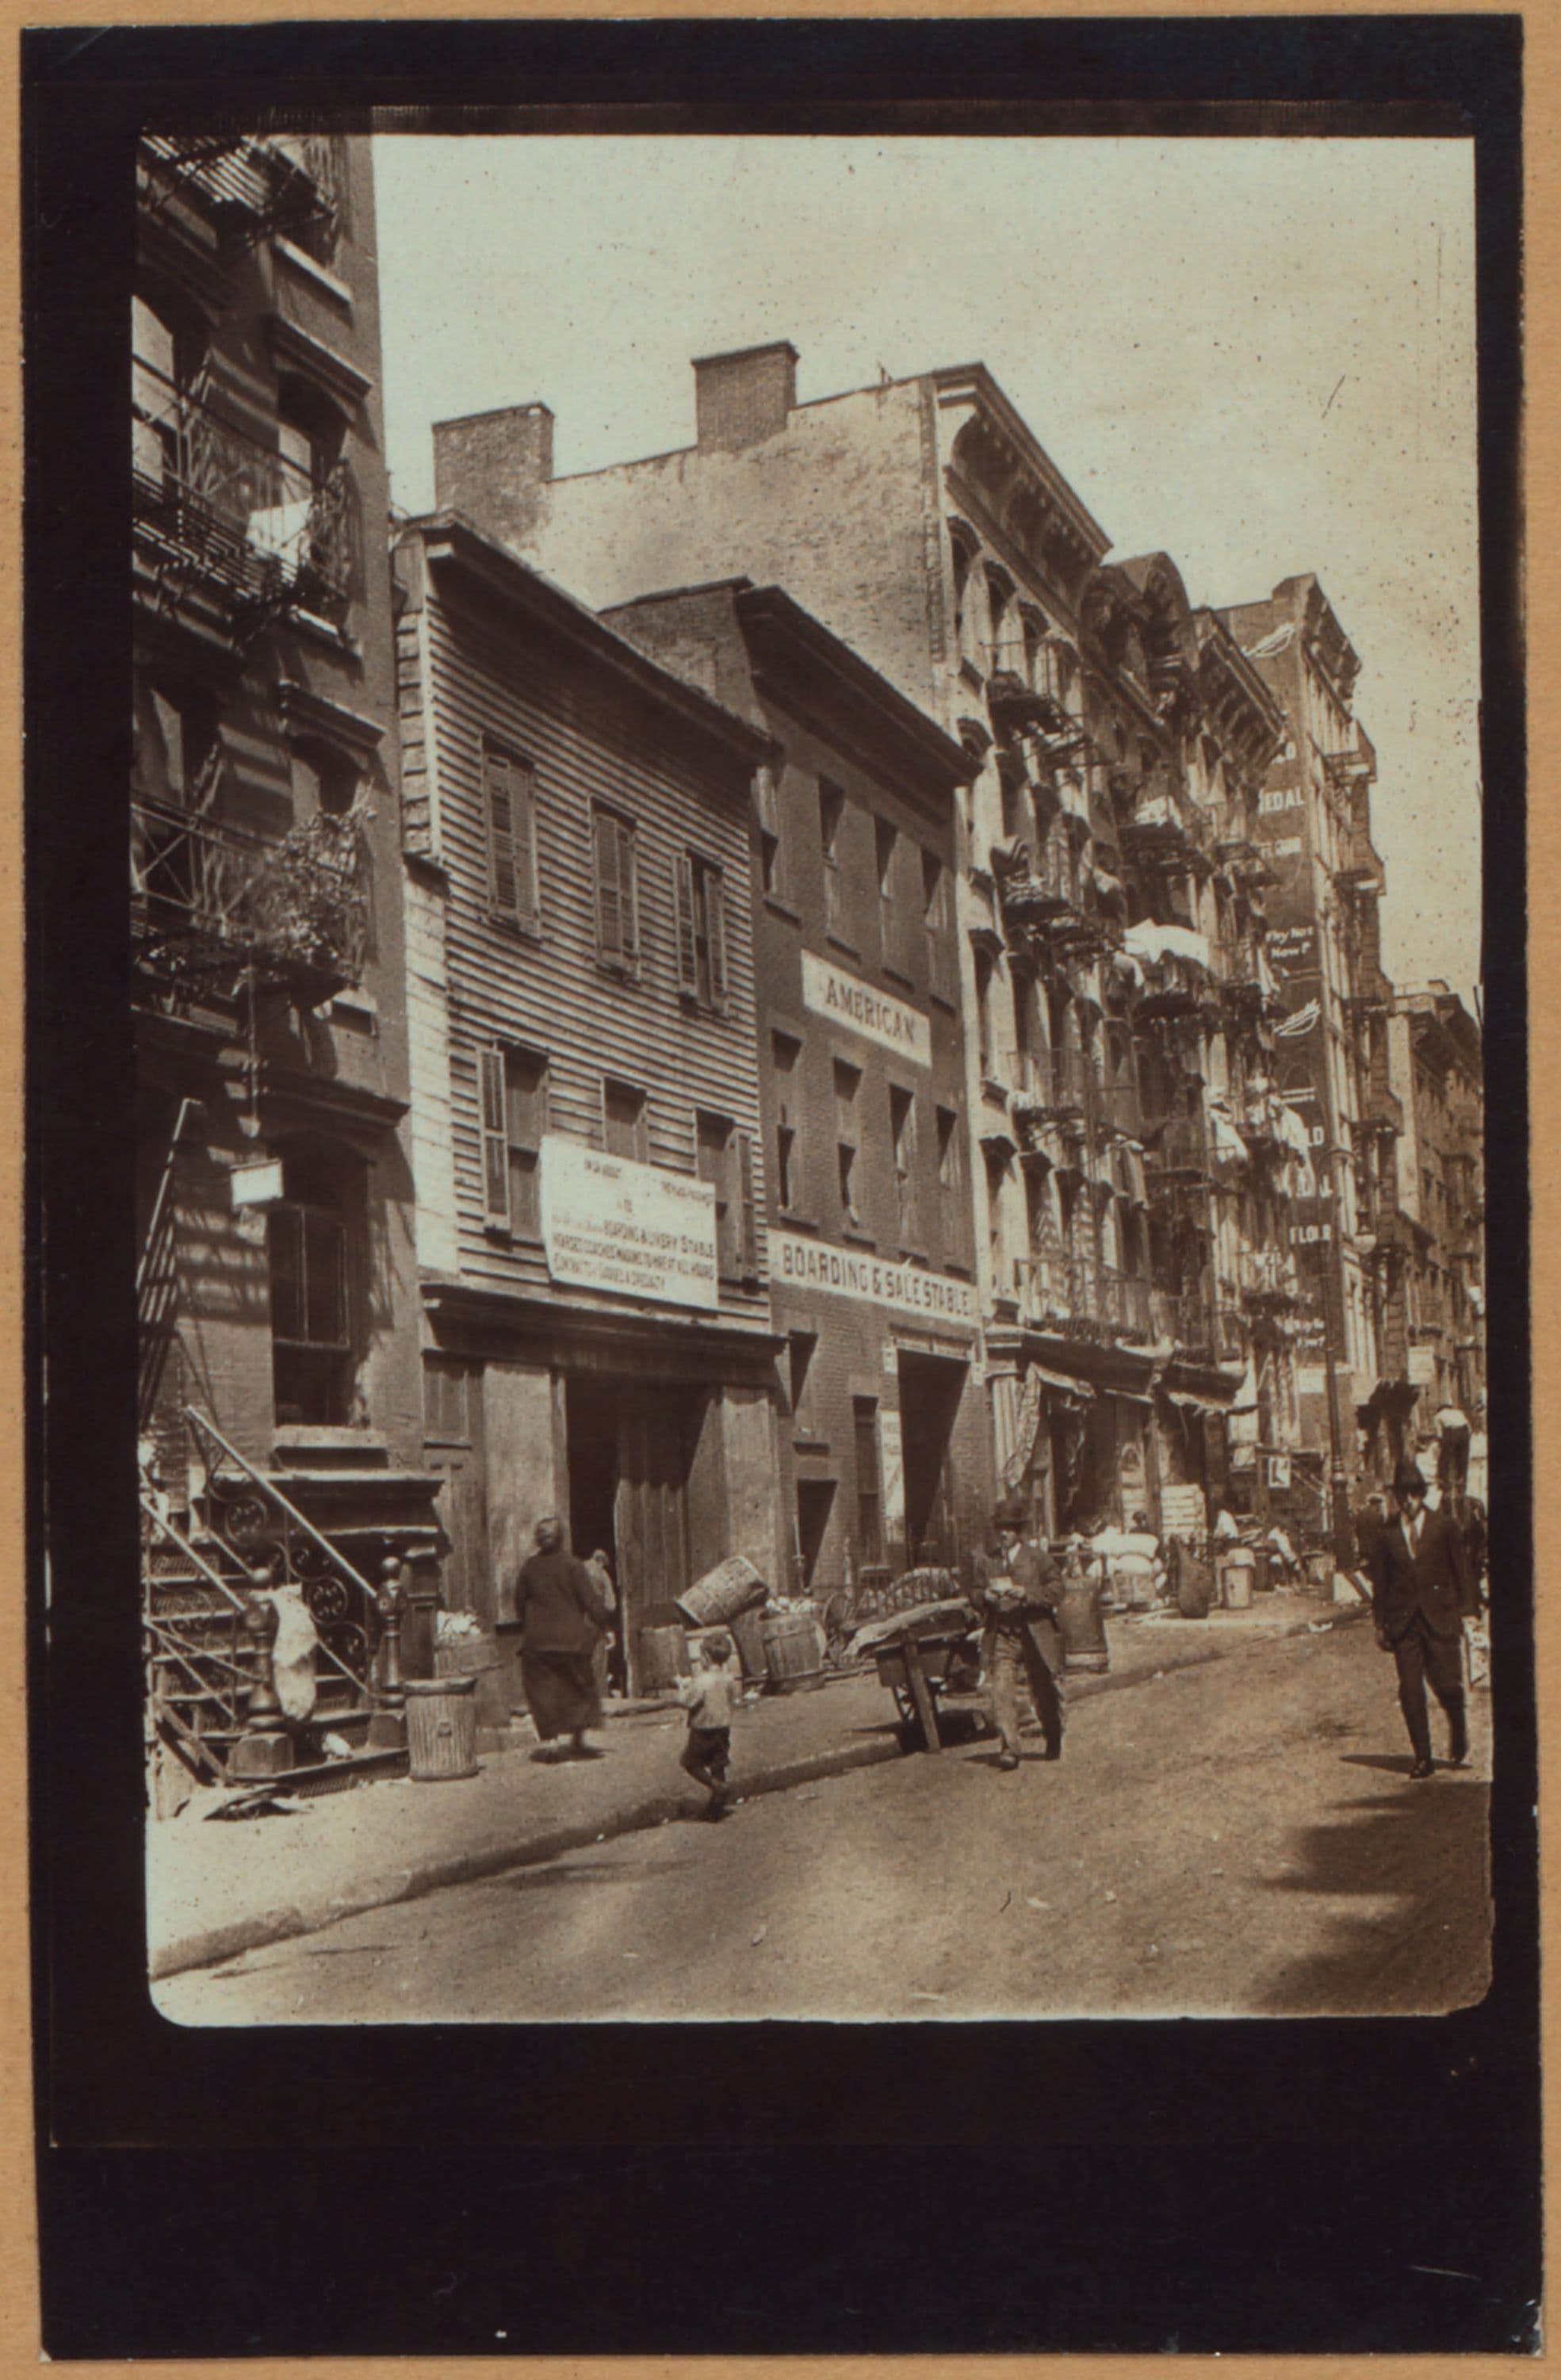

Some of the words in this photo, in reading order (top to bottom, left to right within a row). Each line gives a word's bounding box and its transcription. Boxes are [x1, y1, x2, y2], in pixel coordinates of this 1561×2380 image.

[824, 977, 915, 1045] AMERICAN
[782, 1242, 868, 1292] BOARDING
[872, 1267, 882, 1295] &
[886, 1270, 920, 1305] SALE
